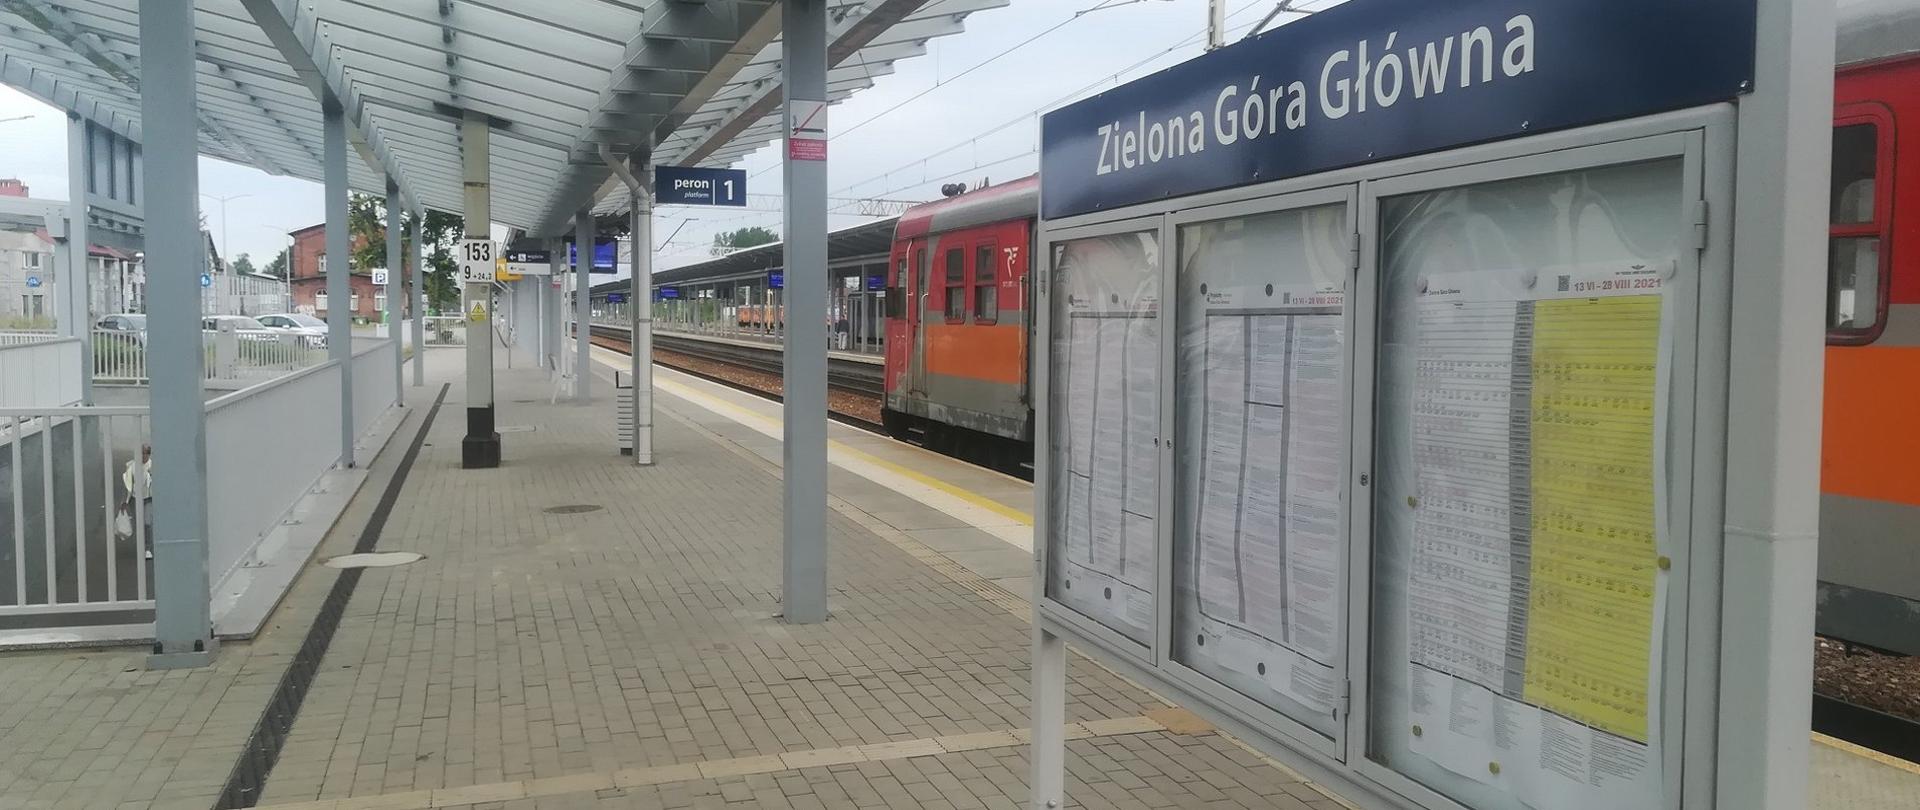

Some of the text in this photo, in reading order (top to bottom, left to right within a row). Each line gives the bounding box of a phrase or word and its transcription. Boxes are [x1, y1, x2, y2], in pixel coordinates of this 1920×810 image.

[1096, 14, 1535, 176] Zielona Góra Główna
[674, 179, 710, 191] peron
[724, 180, 734, 201] 1
[684, 191, 710, 199] platform
[464, 242, 491, 262] 153
[464, 265, 471, 280] 9
[1575, 282, 1585, 292] 13
[1586, 281, 1595, 291] VI
[1602, 280, 1613, 290] 28
[1615, 279, 1631, 289] VIII
[1634, 278, 1662, 289] 2021
